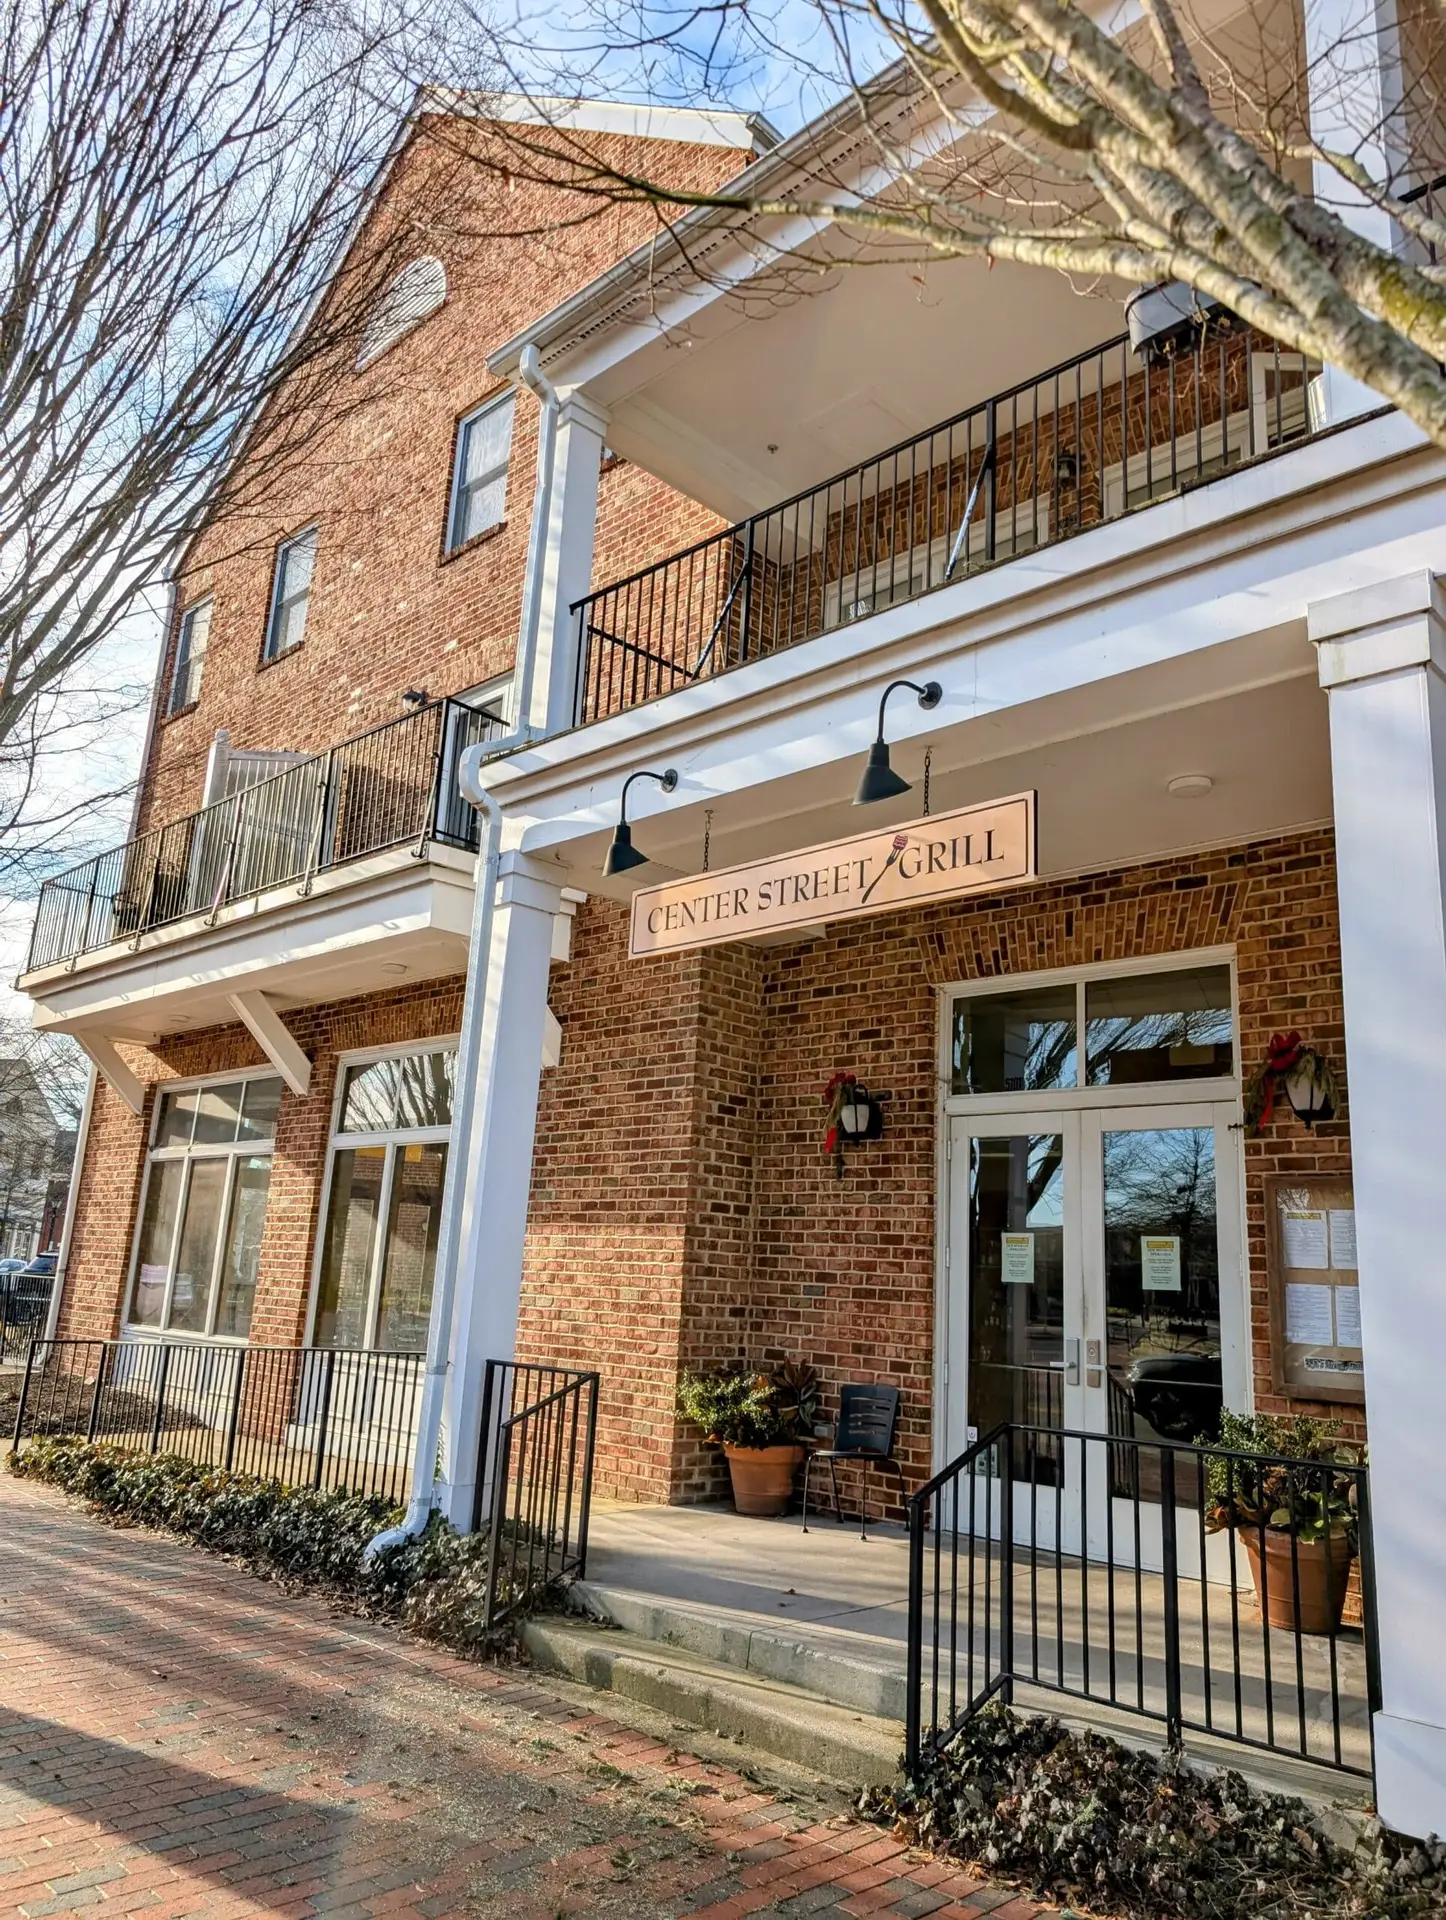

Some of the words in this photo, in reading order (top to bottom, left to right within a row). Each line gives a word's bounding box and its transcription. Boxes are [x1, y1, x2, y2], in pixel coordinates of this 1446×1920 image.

[647, 887, 749, 934] CENTER
[757, 857, 873, 912] STREET
[899, 829, 1004, 879] GRILL
